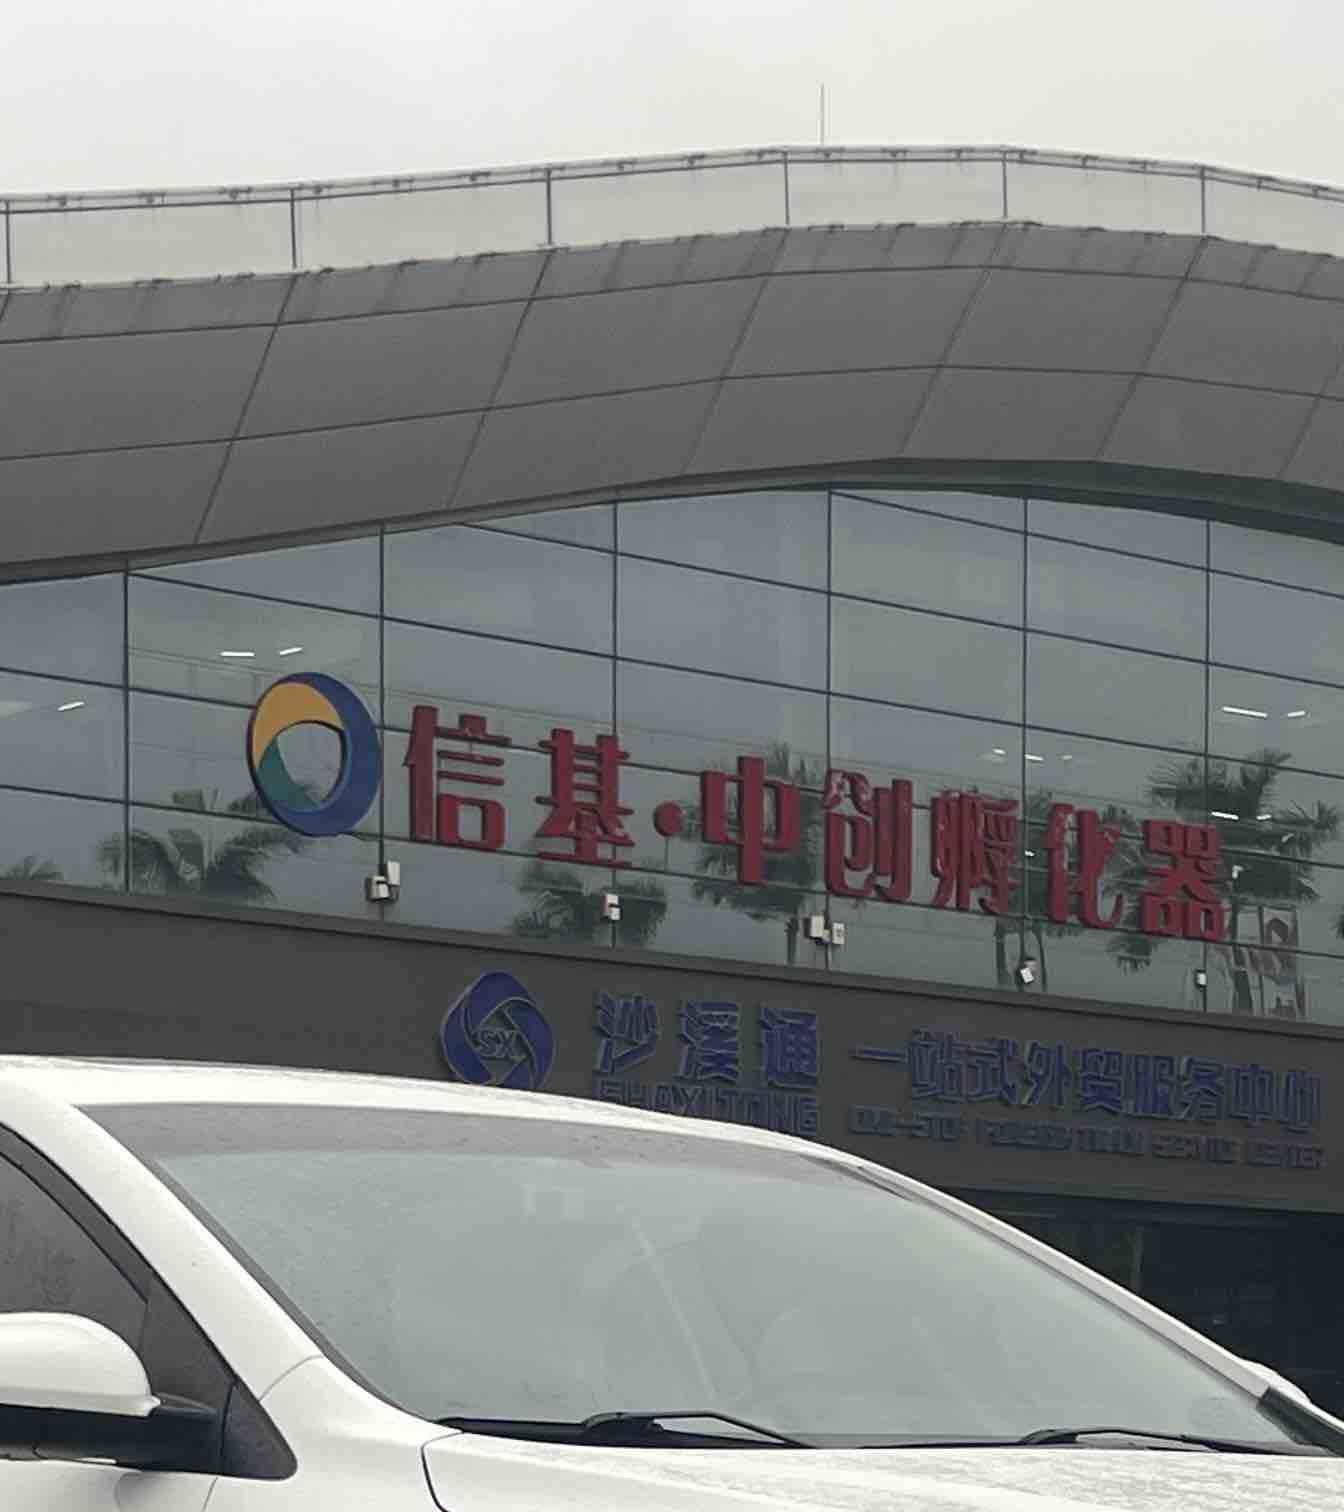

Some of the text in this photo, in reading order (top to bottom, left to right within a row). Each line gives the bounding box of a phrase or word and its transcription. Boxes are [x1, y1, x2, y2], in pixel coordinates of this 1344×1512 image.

[404, 703, 1230, 942] 信基·中创孵化器
[592, 991, 819, 1090] 沙溪通
[849, 1027, 1324, 1136] 一站式外贸服务中心
